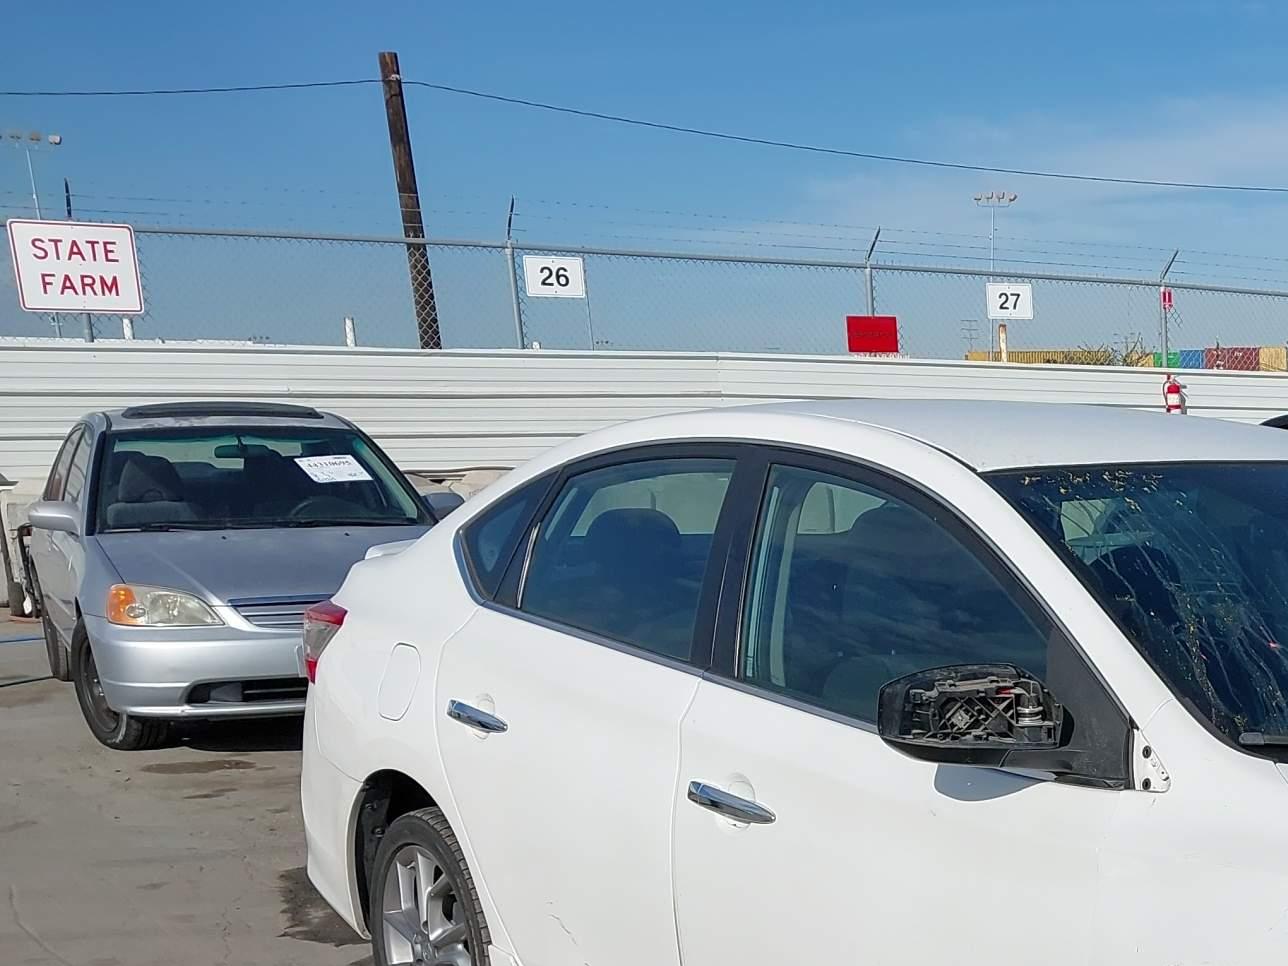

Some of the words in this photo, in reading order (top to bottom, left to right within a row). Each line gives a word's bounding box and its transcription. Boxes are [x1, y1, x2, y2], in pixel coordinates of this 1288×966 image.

[31, 238, 119, 262] STATE
[41, 273, 119, 296] FARM
[540, 266, 569, 287] 26
[998, 292, 1021, 310] 27
